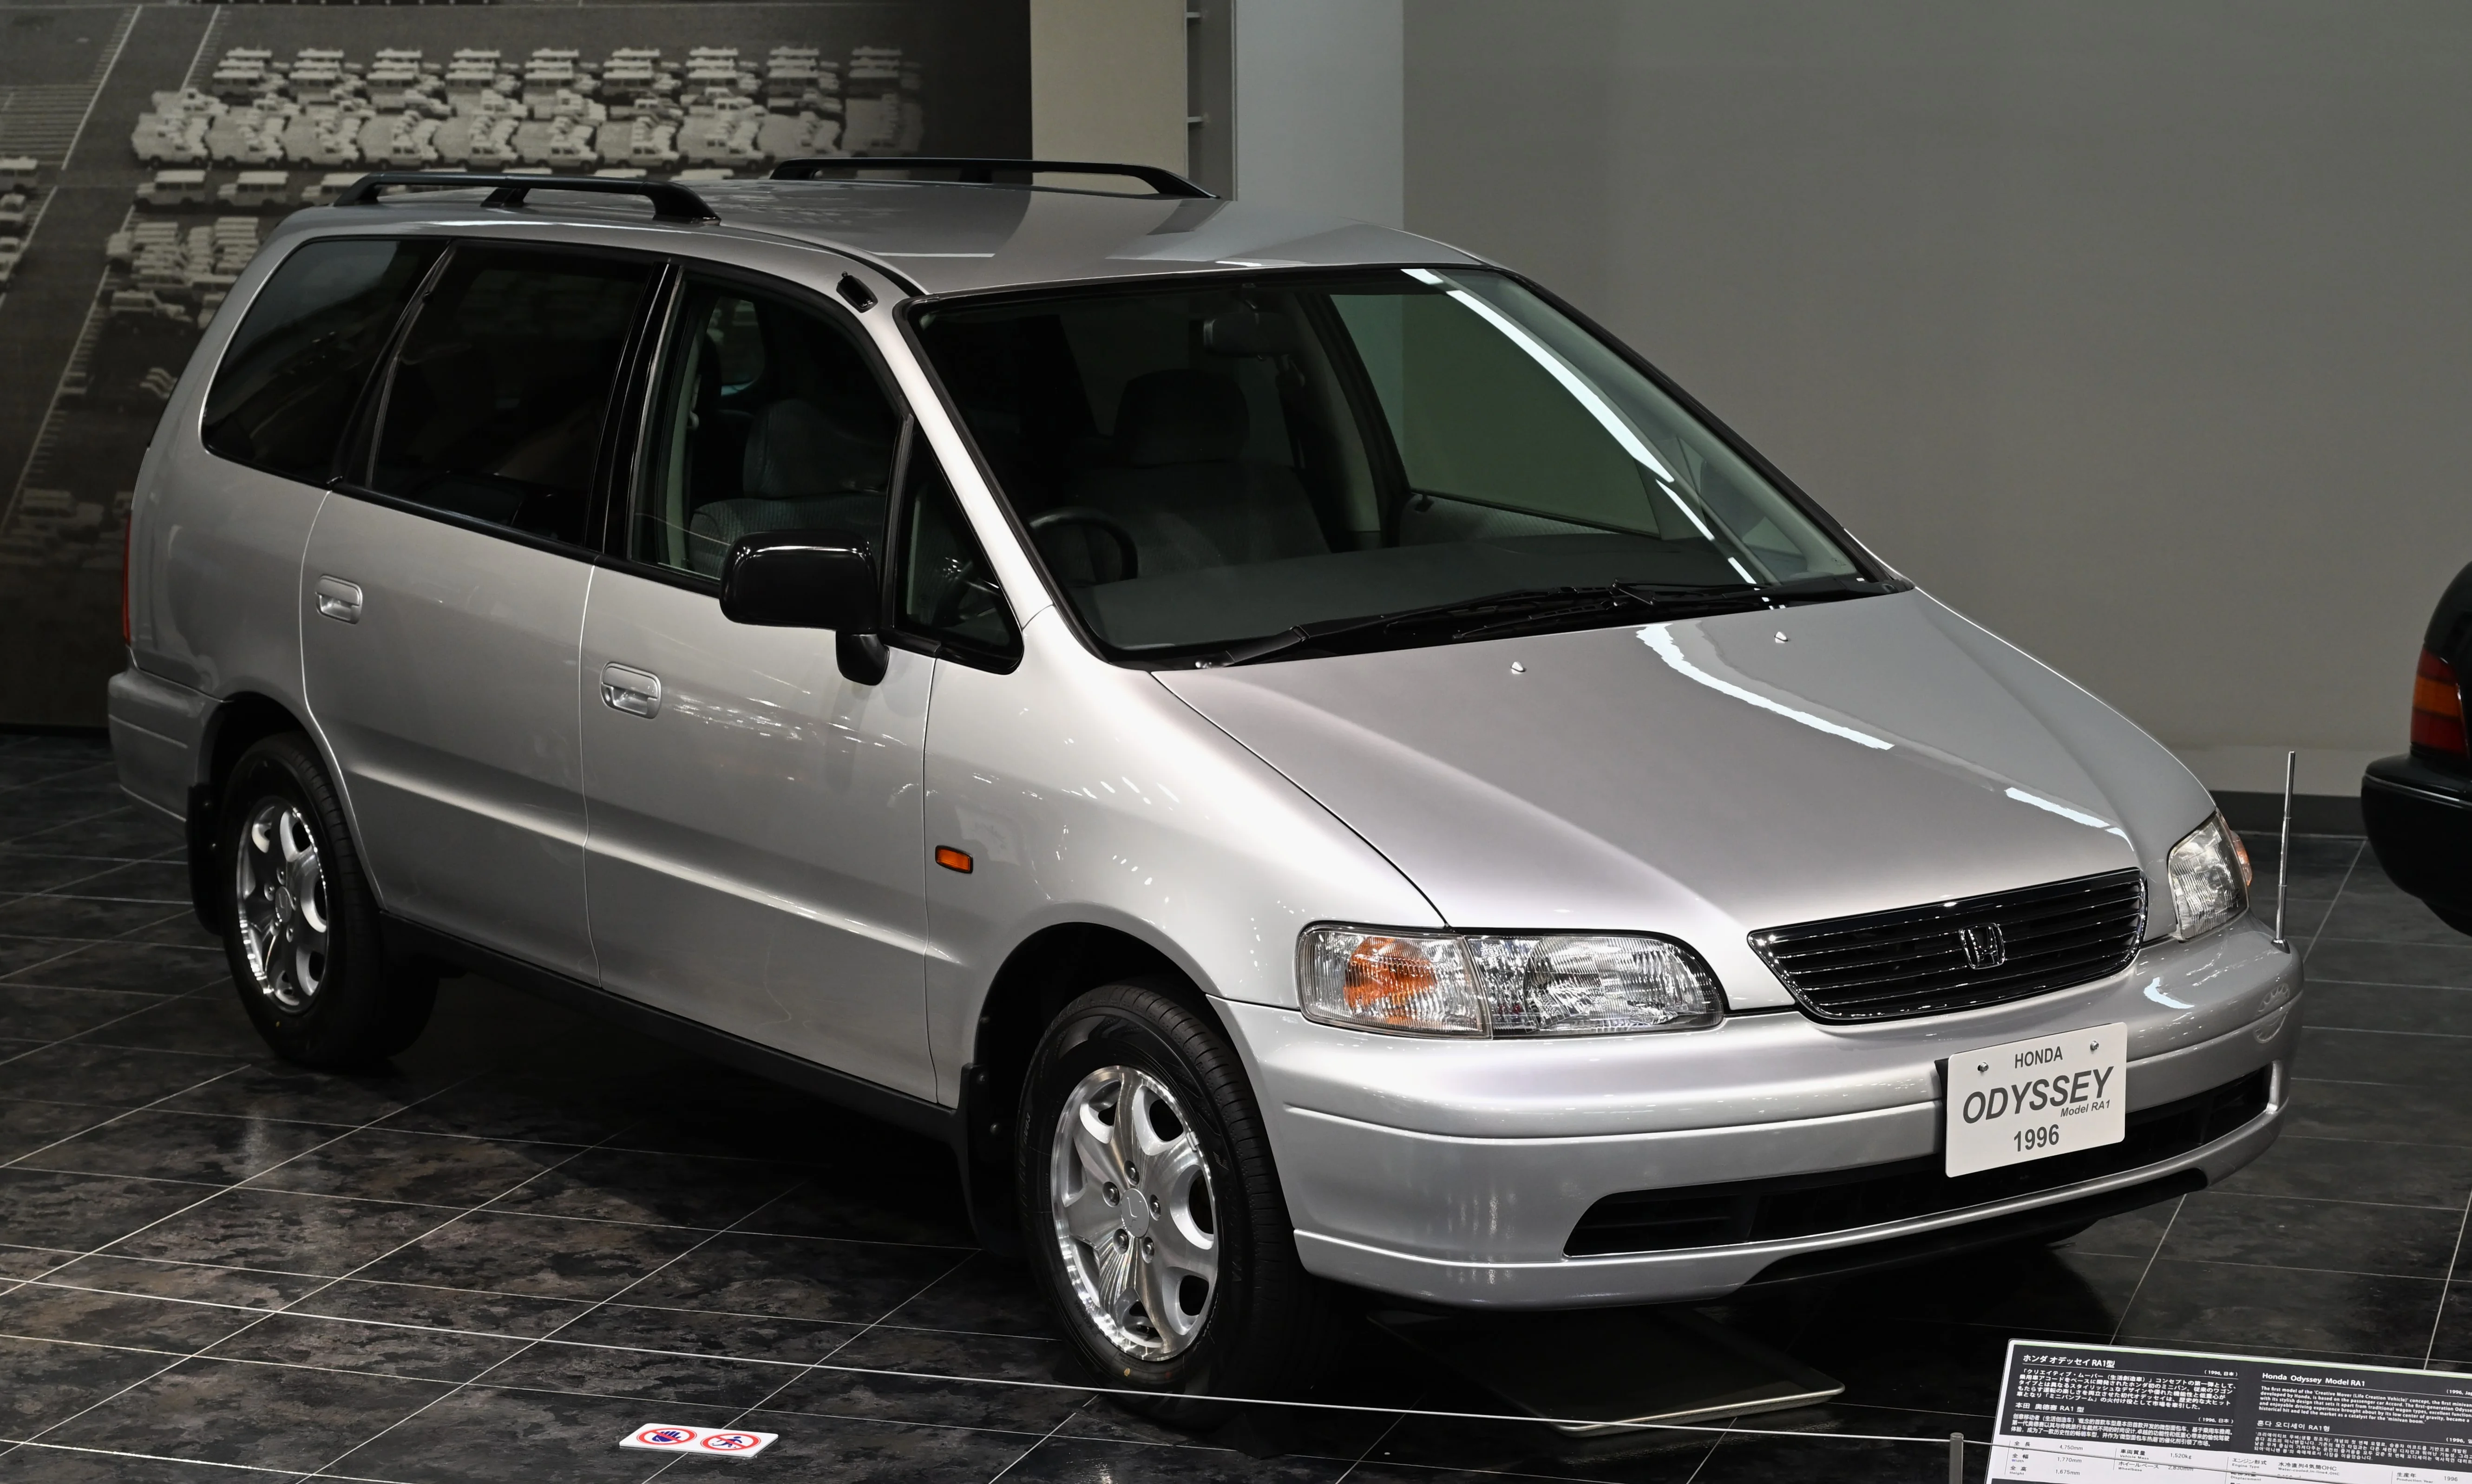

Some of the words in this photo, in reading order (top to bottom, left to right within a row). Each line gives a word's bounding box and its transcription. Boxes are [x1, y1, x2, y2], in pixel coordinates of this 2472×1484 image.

[2014, 1046, 2063, 1069] HONDA
[1963, 1066, 2114, 1124] ODYSSEY
[2060, 1104, 2089, 1117] Model
[2091, 1099, 2111, 1111] RA1
[2013, 1124, 2059, 1152] 1996
[2023, 1354, 2048, 1363] ホンダ
[2049, 1356, 2090, 1366] オデッセイ
[2092, 1359, 2115, 1368] RA1型
[2290, 1375, 2322, 1384] Odyssey
[2275, 1421, 2305, 1430] 오디세이
